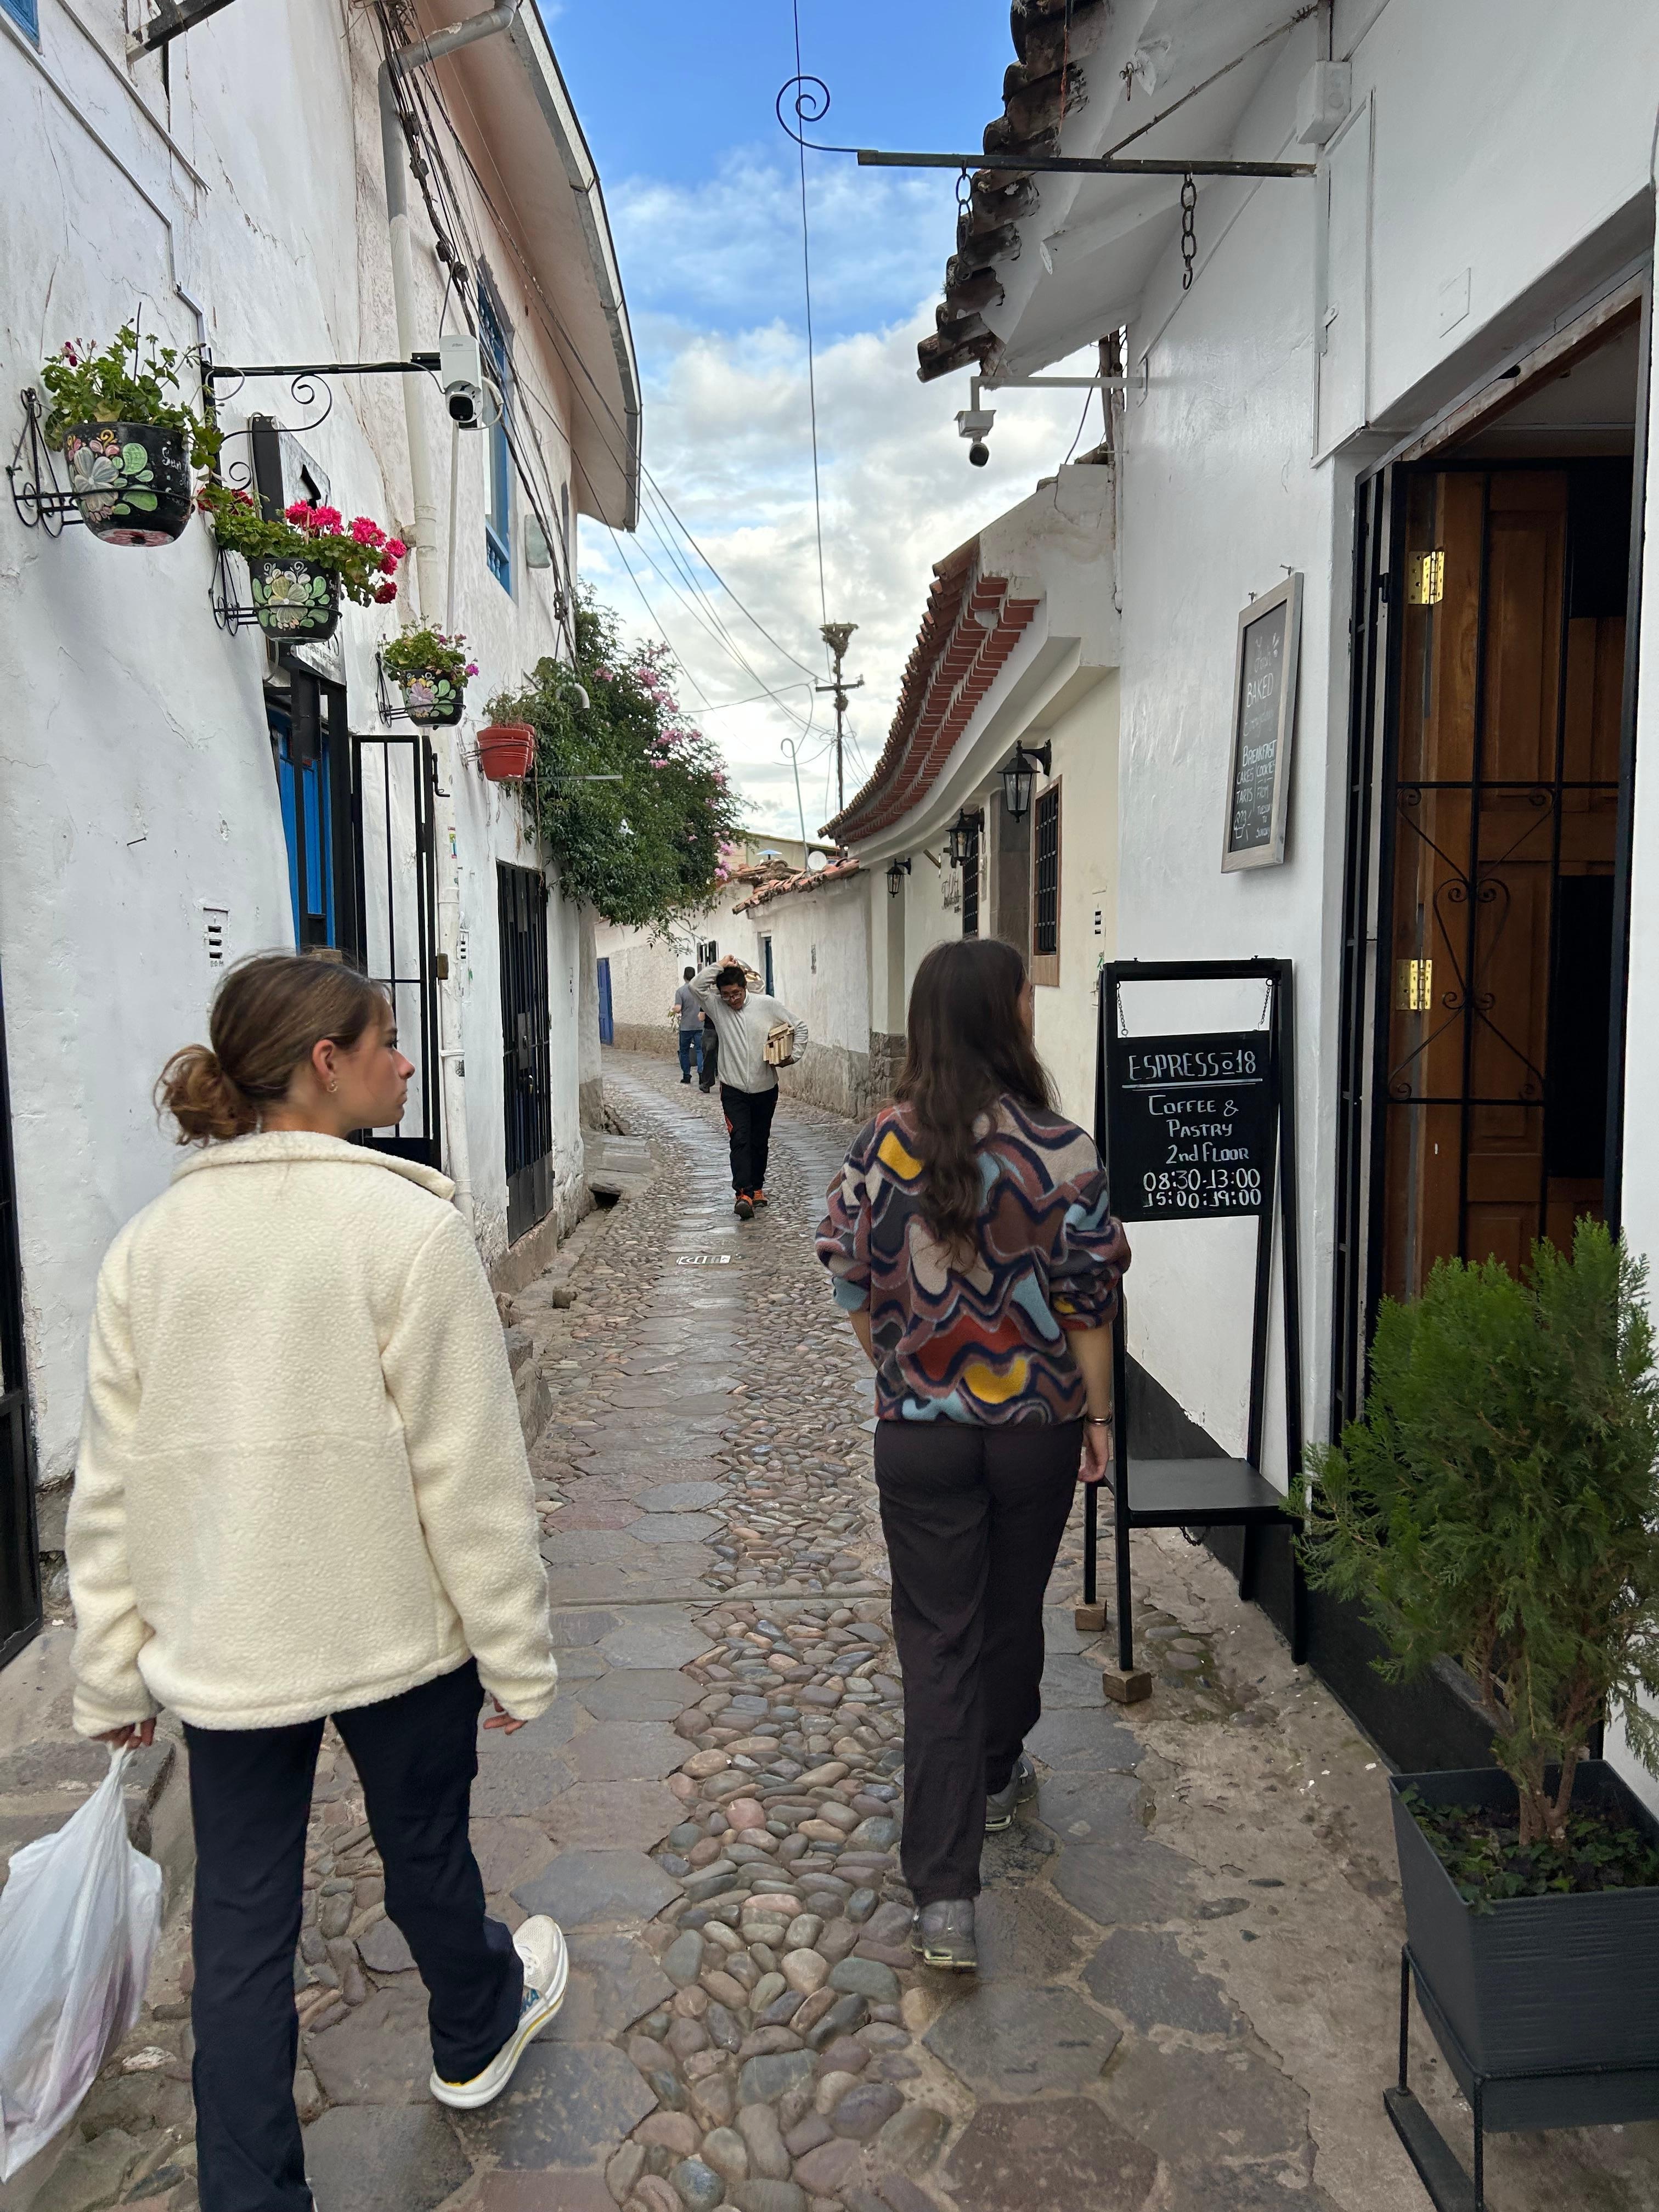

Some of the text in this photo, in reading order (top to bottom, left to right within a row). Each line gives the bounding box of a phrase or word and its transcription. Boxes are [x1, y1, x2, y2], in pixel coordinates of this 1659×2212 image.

[1246, 673, 1273, 708] BAKED
[1242, 739, 1278, 767] BREAKFAST
[1237, 767, 1254, 785] CAKES
[1237, 787, 1253, 804] TARTS
[1148, 1094, 1239, 1116] COFFEE &
[1165, 1119, 1233, 1138] PASTRY
[1165, 1141, 1250, 1164] 2nd FLOOR
